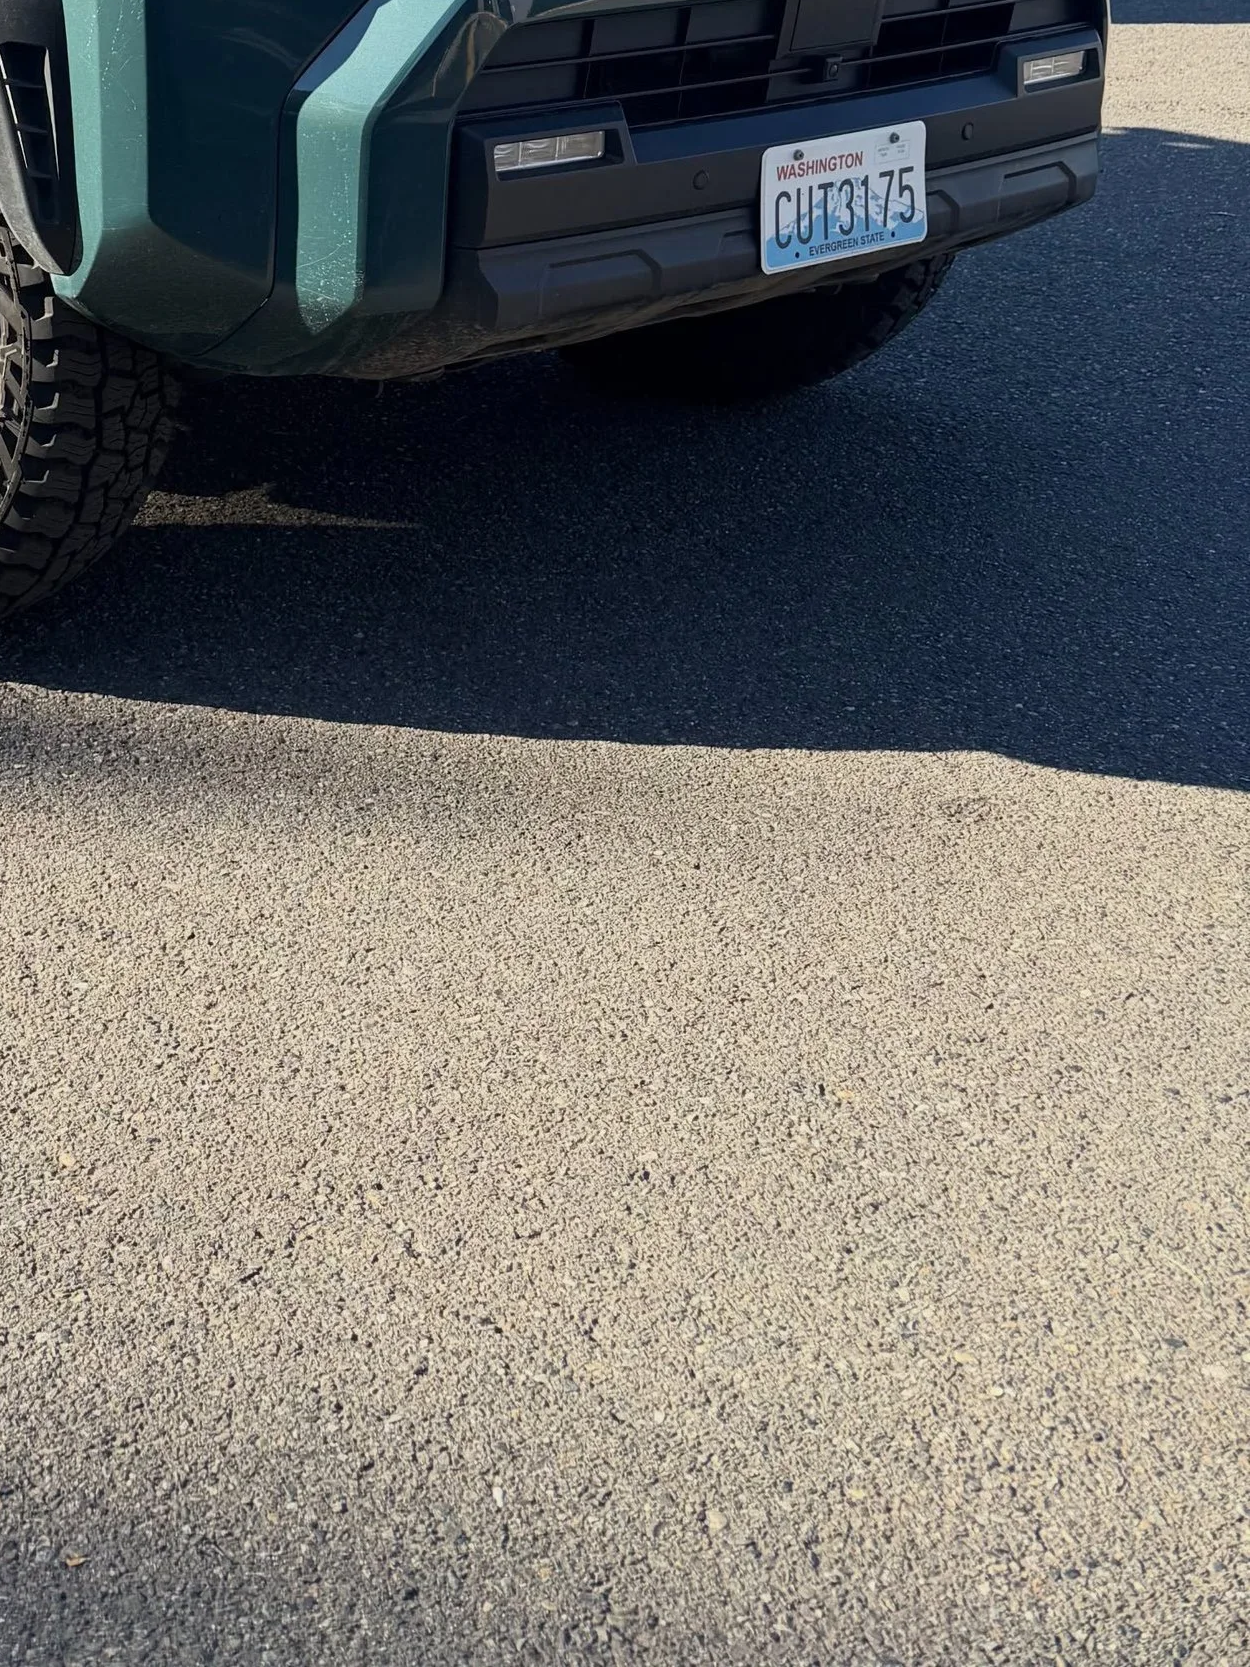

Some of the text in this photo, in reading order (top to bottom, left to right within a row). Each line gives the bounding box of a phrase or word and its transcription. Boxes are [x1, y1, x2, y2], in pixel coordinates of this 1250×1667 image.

[776, 151, 864, 182] WASHINGTON
[774, 165, 916, 249] CUT3175
[808, 231, 885, 257] EVERGREEN STATE
